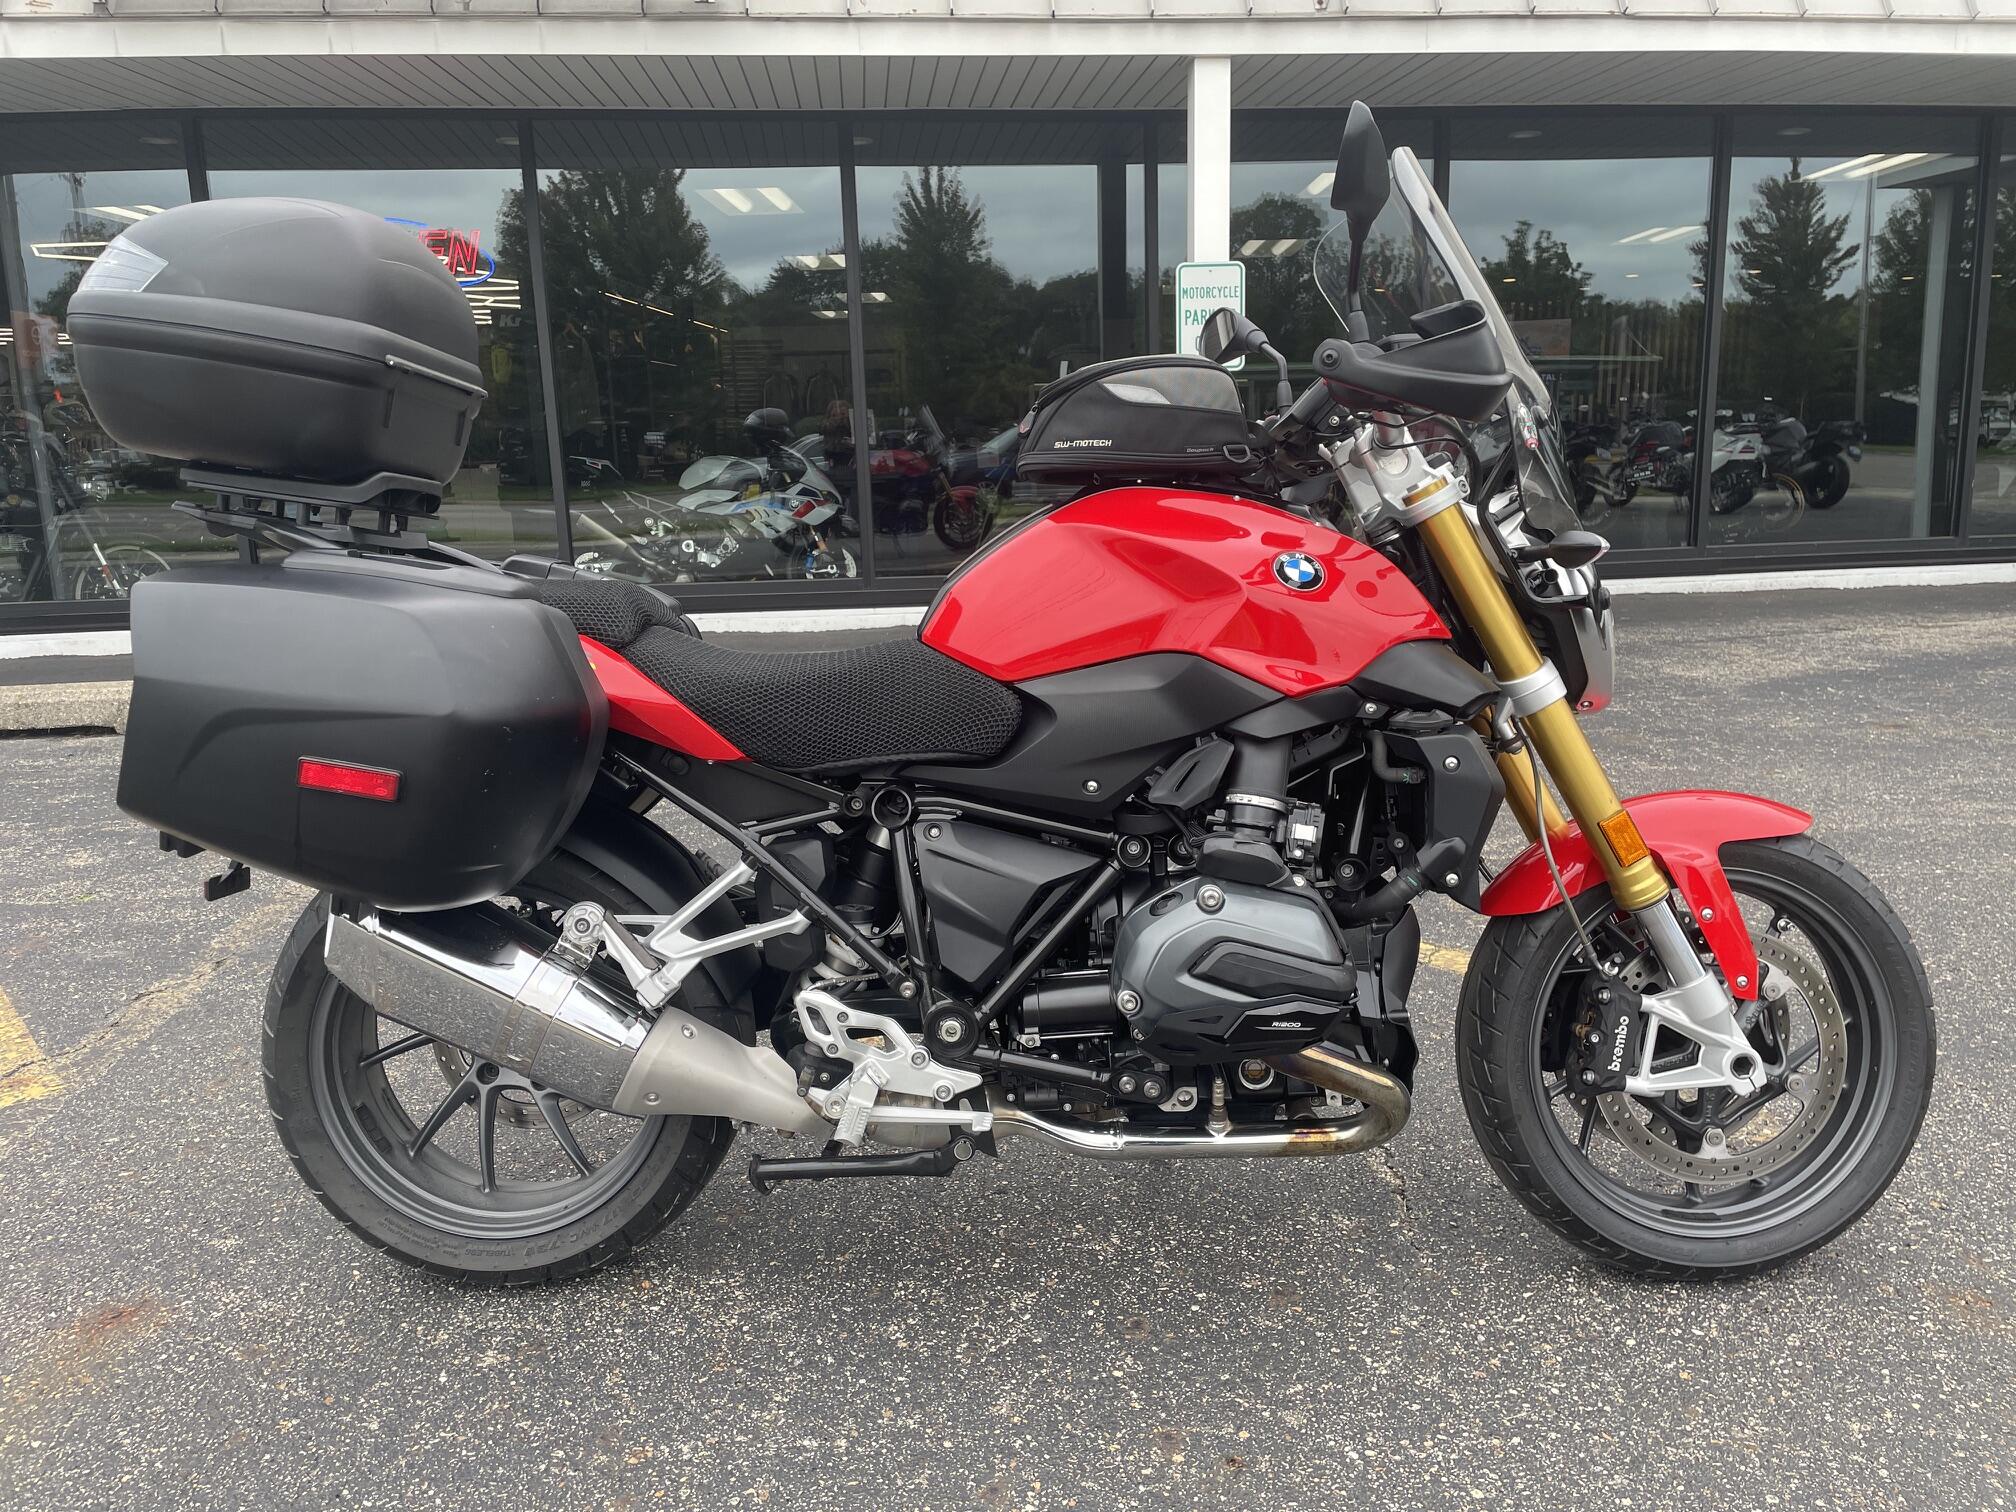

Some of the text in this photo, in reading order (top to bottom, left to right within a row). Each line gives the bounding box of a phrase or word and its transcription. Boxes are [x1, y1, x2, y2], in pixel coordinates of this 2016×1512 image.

[1182, 285, 1239, 299] MOTORCYCLE
[1054, 439, 1112, 449] SW-MOTECH
[1607, 1015, 1630, 1072] brembo
